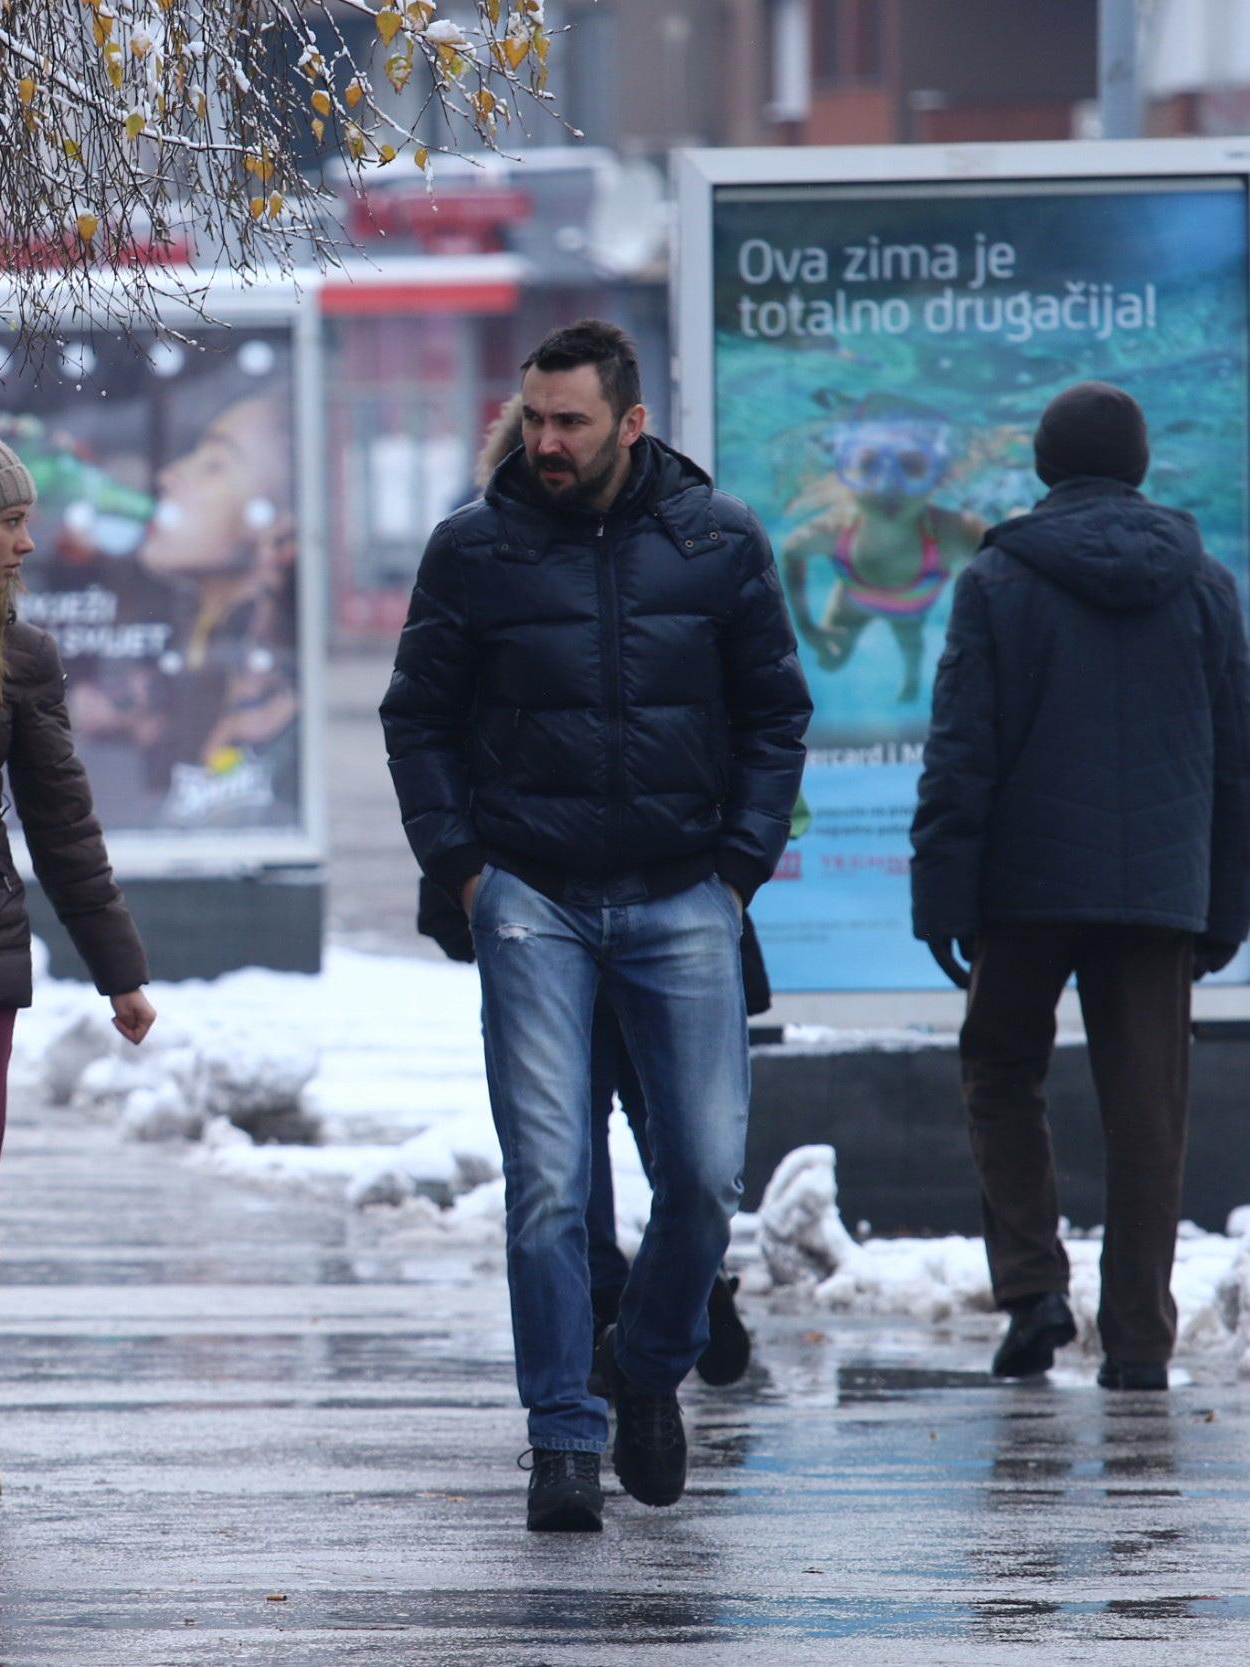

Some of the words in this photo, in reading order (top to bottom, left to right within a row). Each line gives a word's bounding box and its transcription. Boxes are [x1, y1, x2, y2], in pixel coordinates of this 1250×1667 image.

[738, 239, 828, 285] Ova
[842, 235, 959, 282] zima
[967, 232, 1016, 289] je
[738, 288, 910, 338] totalno
[924, 280, 1156, 342] drugačija!
